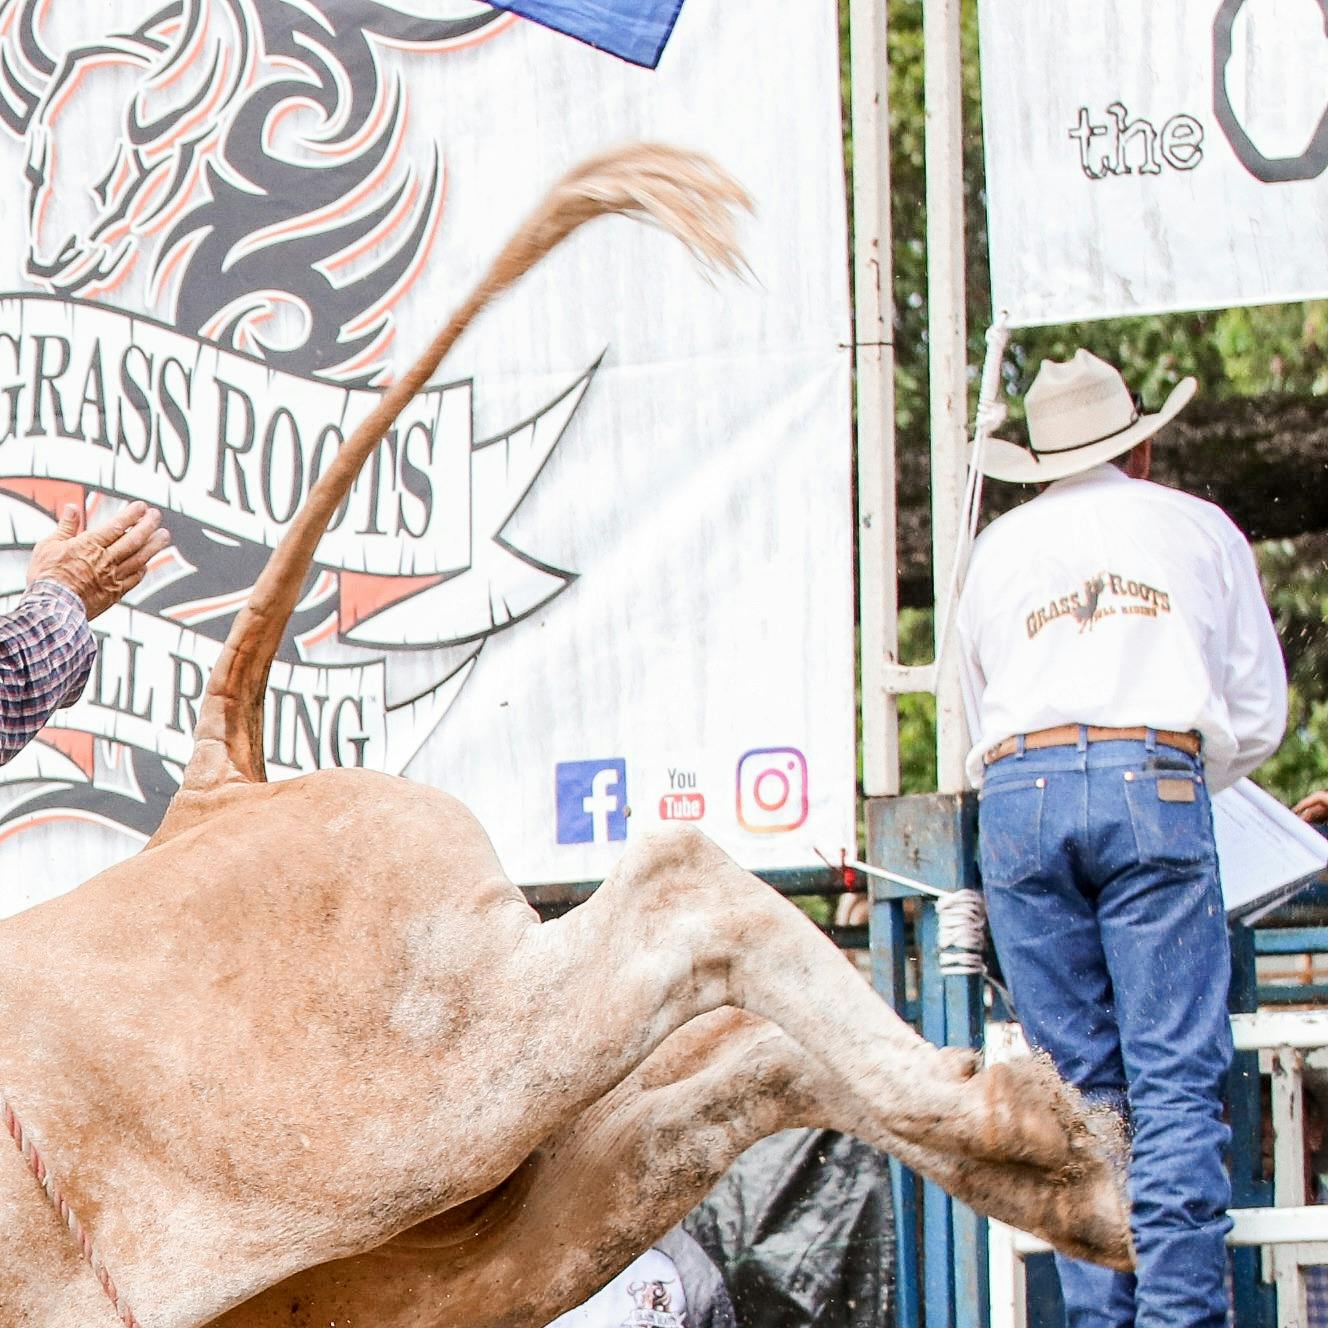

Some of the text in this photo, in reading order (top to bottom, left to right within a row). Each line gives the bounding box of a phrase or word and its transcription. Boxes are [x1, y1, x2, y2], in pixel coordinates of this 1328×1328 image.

[1069, 102, 1204, 179] the
[1107, 571, 1172, 613] ROOTS
[87, 630, 371, 770] LL RING
[667, 767, 697, 790] You
[664, 794, 701, 820] Tube
